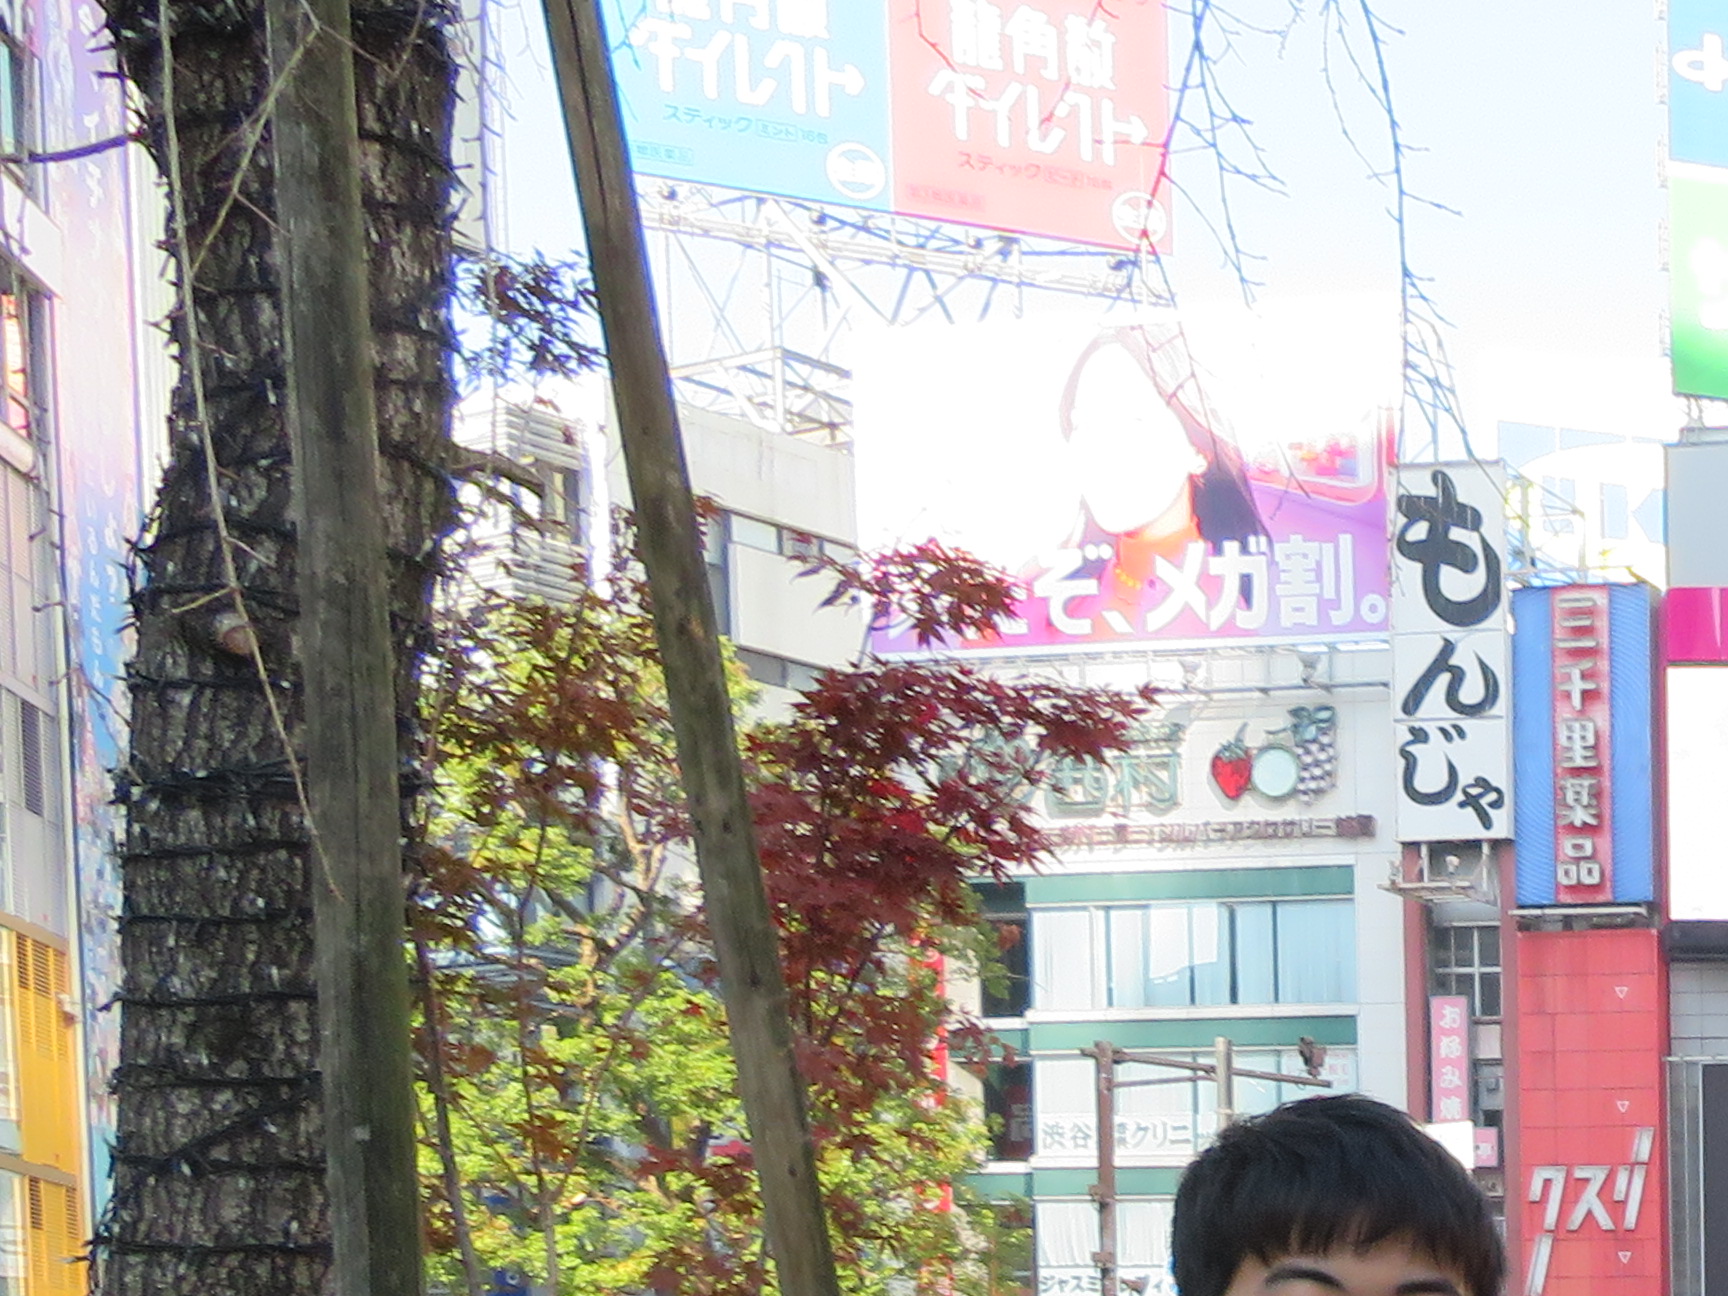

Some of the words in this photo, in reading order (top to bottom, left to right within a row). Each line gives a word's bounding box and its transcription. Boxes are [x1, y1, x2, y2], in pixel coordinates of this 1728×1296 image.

[1396, 469, 1504, 830] もんじゃ
[1555, 595, 1601, 887] 三千里薬品
